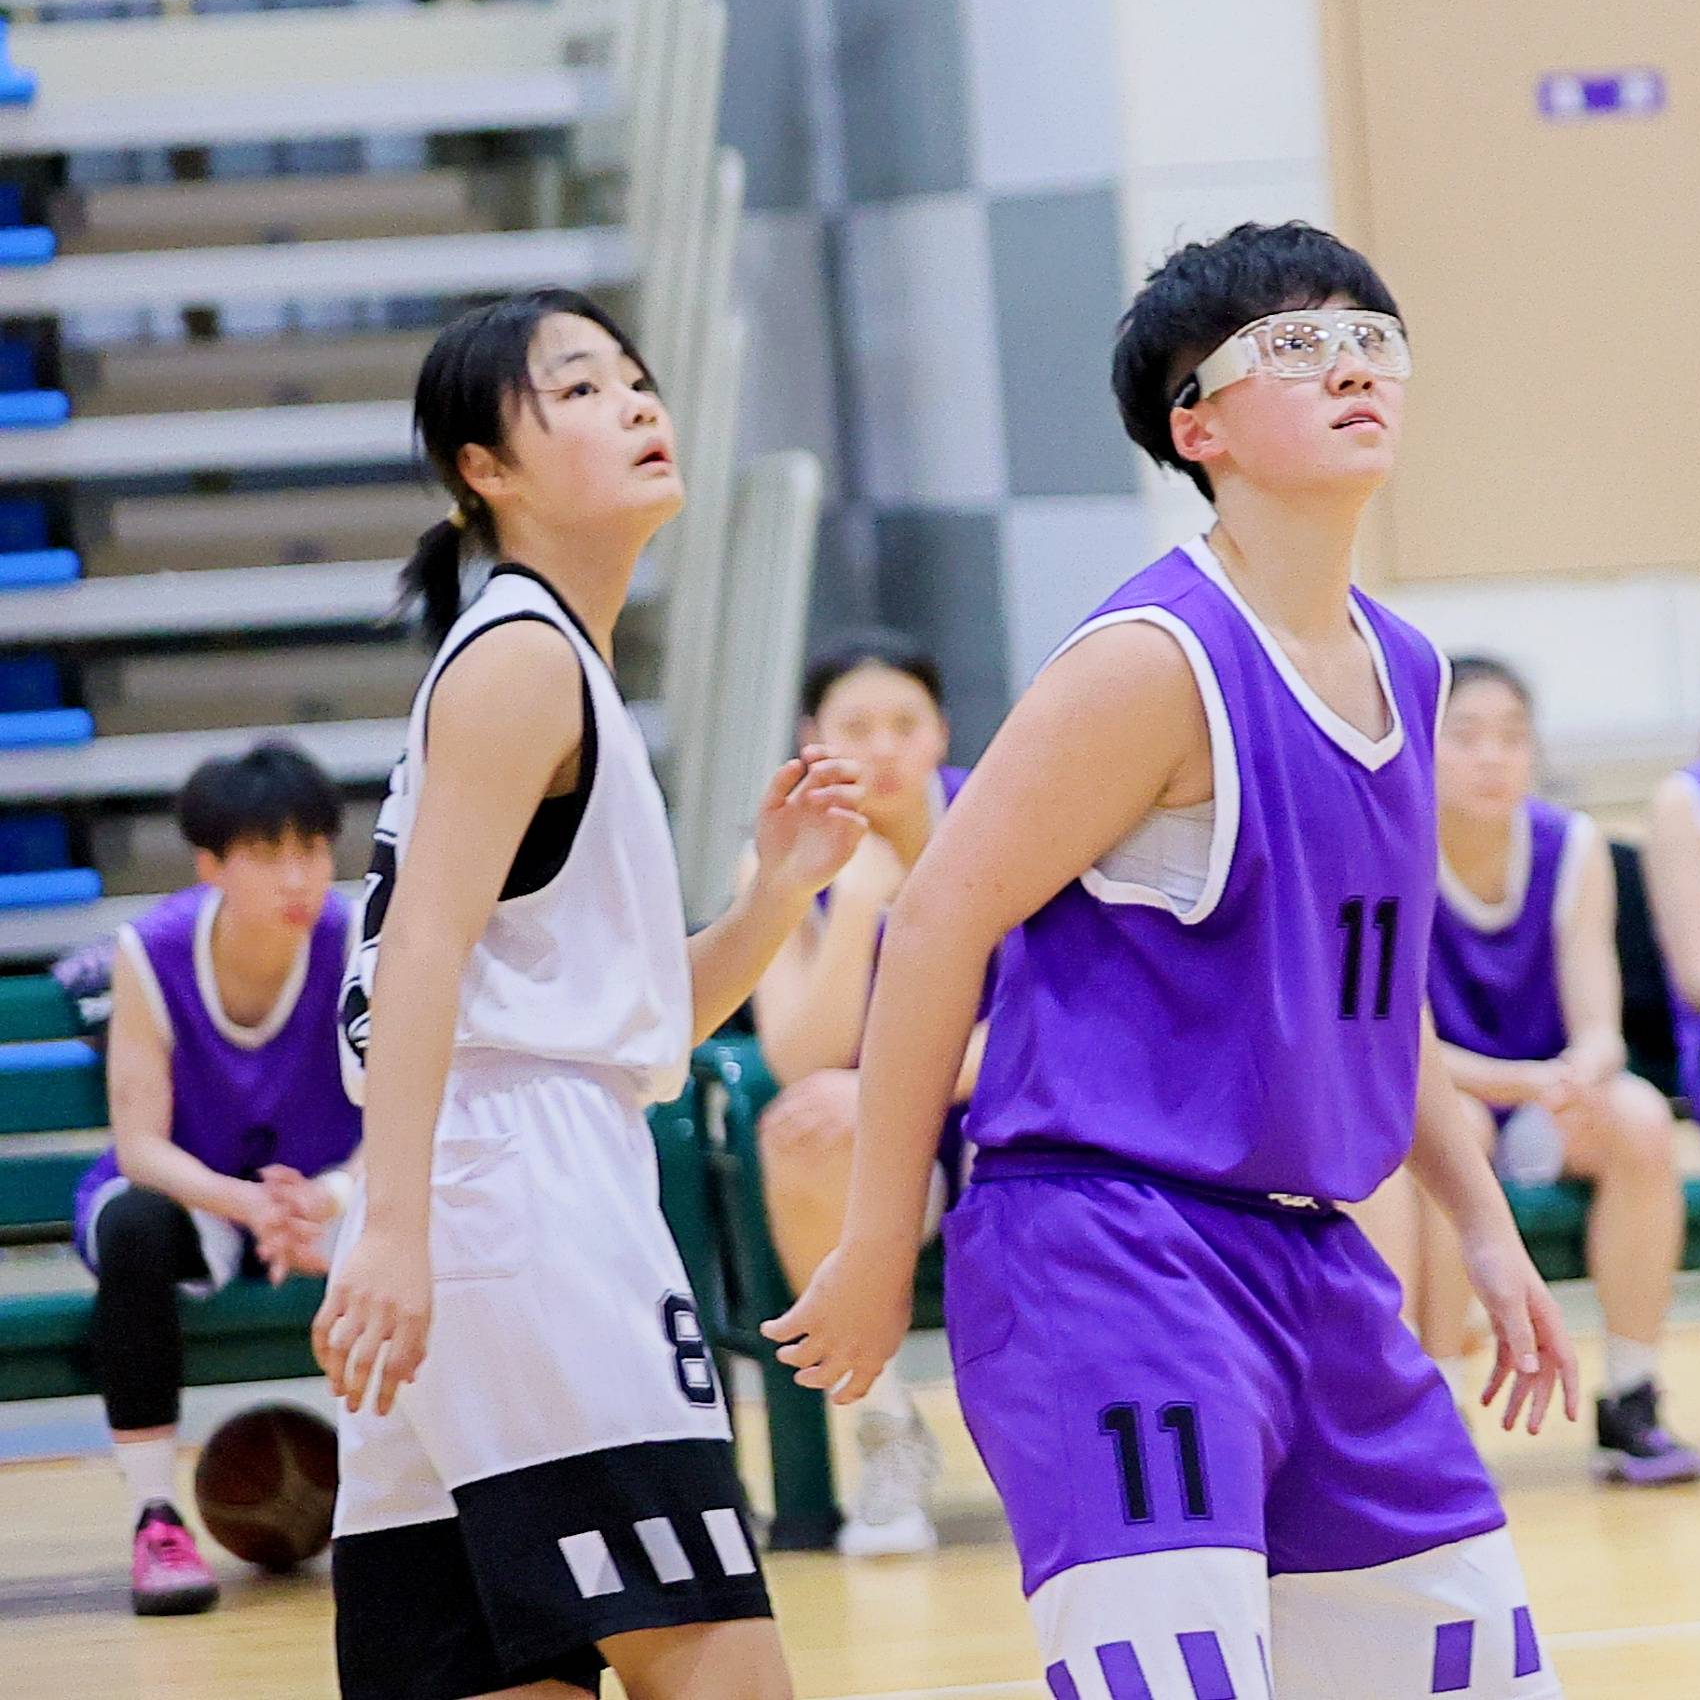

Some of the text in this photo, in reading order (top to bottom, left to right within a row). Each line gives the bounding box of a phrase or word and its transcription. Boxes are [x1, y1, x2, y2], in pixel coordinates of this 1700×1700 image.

[1338, 894, 1401, 1020] 11
[656, 1288, 718, 1408] 8
[1097, 1401, 1213, 1525] 11
